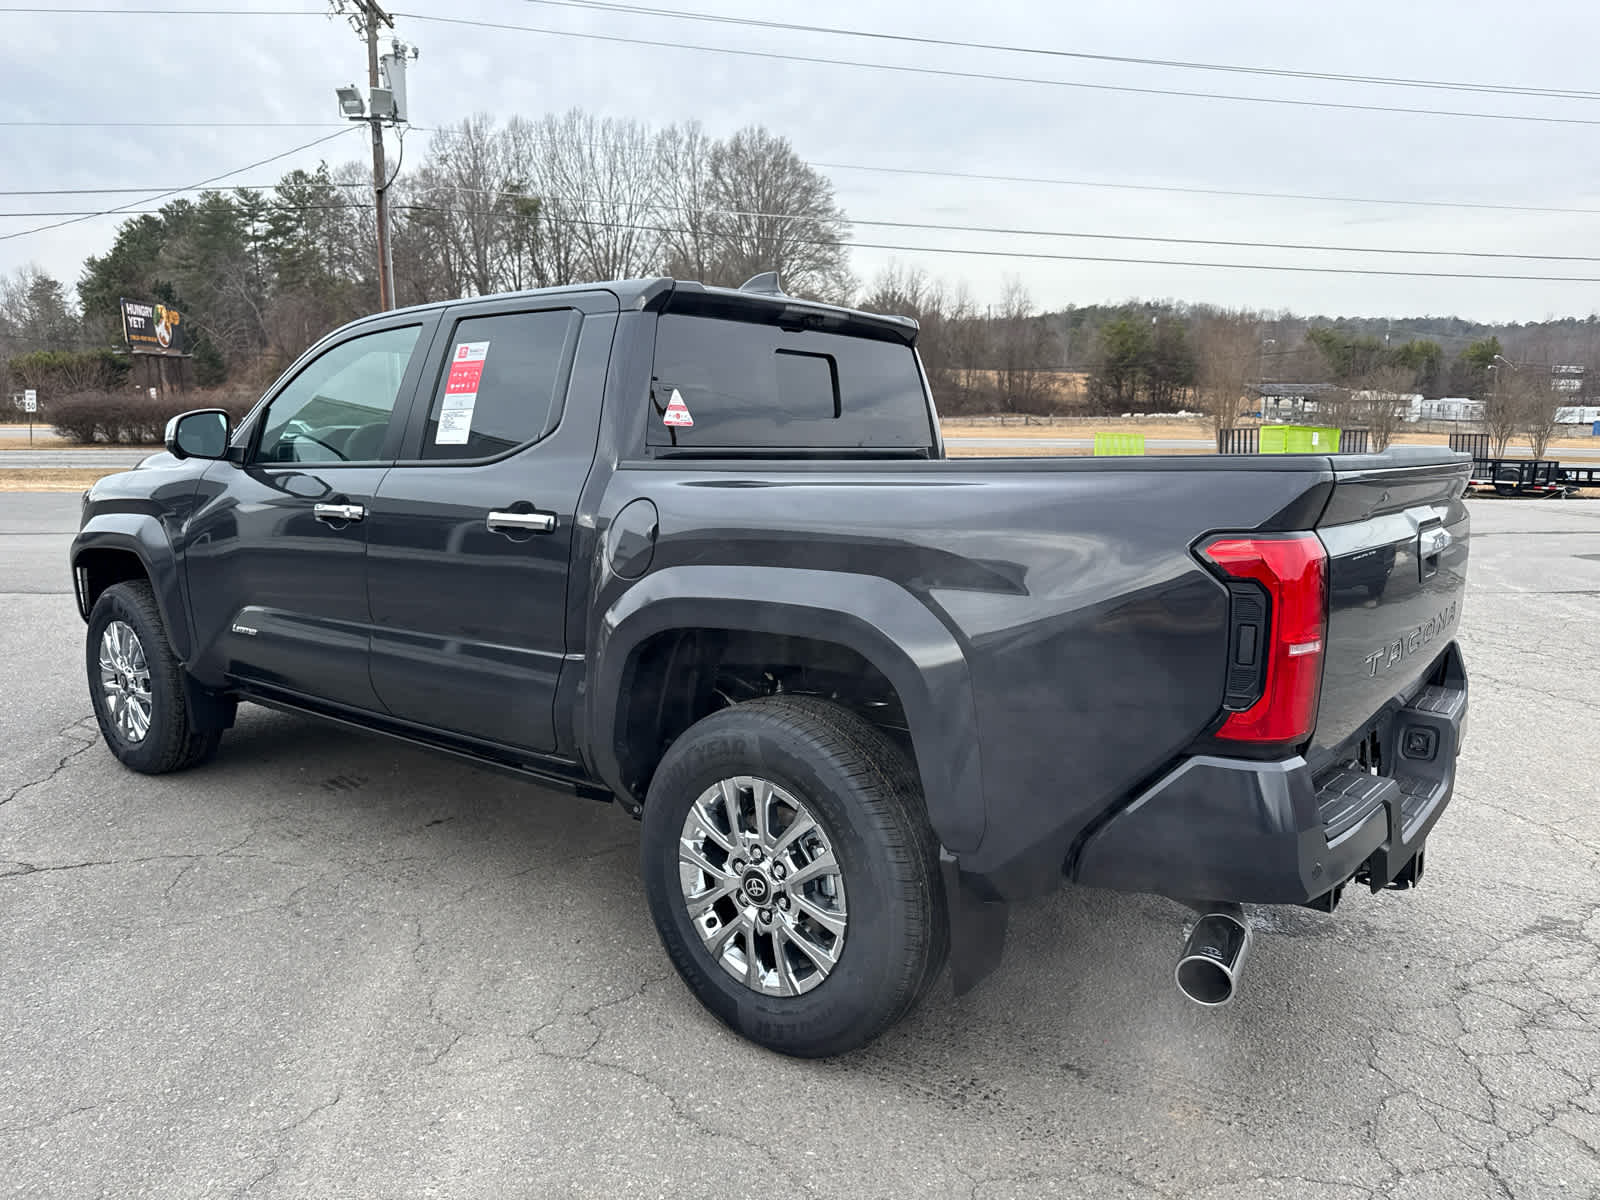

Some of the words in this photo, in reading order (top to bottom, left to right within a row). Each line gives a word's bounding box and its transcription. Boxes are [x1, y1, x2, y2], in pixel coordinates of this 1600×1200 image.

[126, 303, 153, 318] HUNGRY
[128, 316, 145, 329] YET?
[1362, 600, 1457, 678] TACOMA
